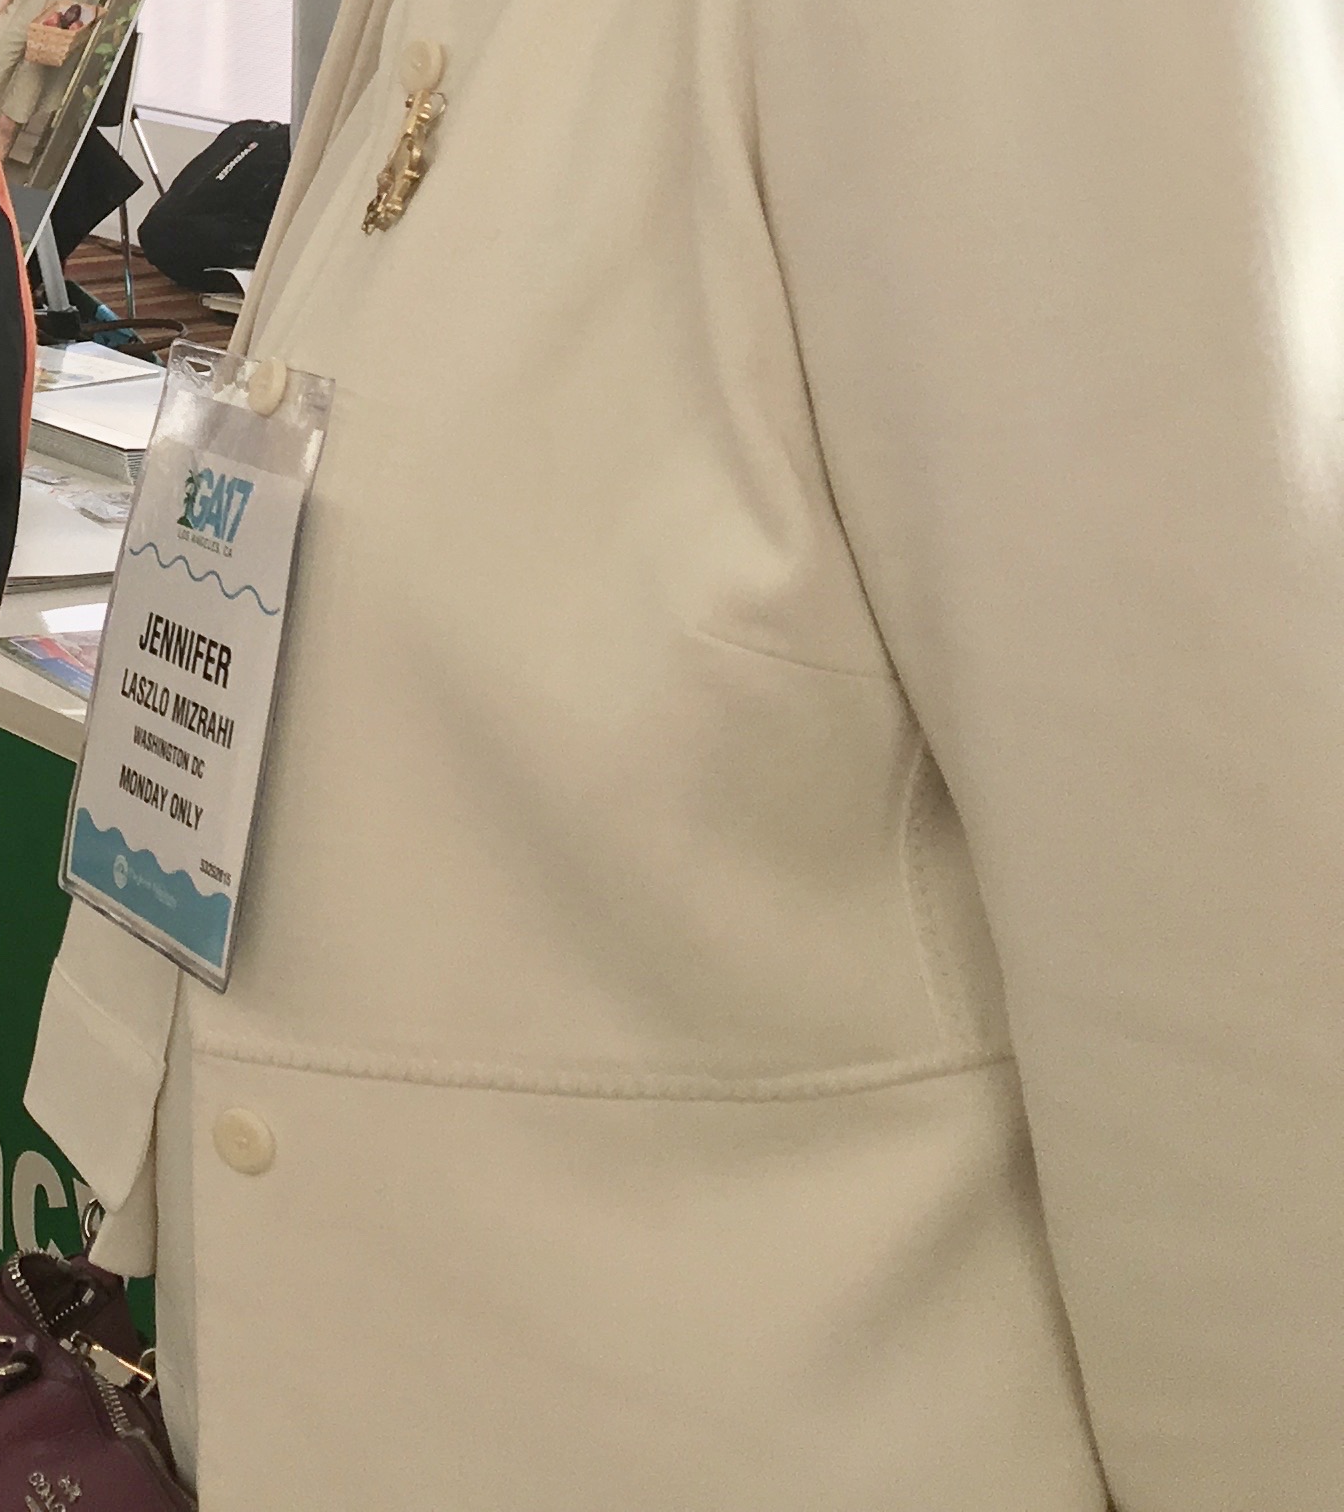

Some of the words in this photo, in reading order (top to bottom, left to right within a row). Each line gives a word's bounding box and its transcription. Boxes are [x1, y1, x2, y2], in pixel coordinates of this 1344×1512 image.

[187, 467, 255, 543] GA17
[139, 611, 232, 689] JENNIFER
[121, 667, 170, 717] LASZLO
[171, 691, 235, 750] MIZRAHI
[133, 725, 190, 772] WASHINGTON
[190, 755, 206, 779] DC
[119, 763, 169, 812] MONDAY
[169, 793, 204, 831] ONLY
